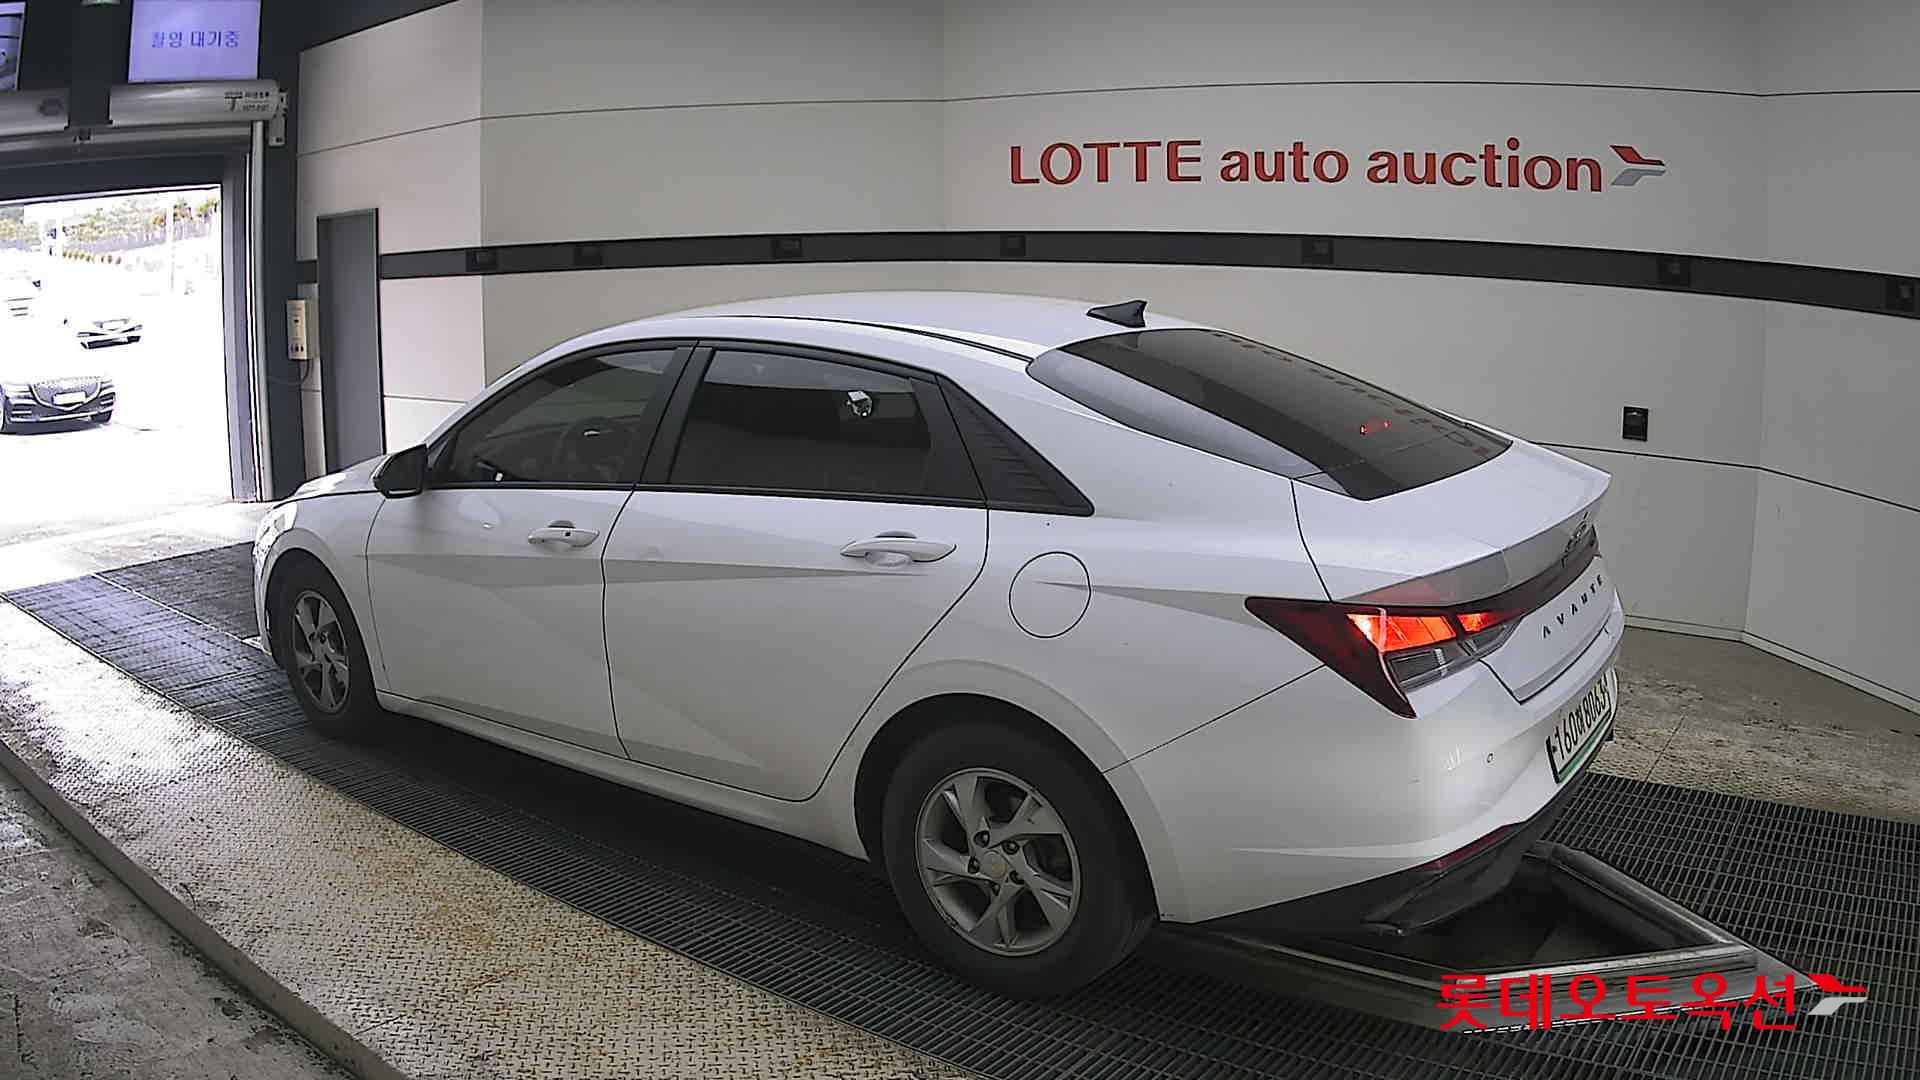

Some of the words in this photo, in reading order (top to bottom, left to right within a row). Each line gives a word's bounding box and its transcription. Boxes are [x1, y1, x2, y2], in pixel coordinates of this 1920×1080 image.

[191, 31, 240, 49] 대기중
[1010, 140, 1201, 185] LOTTE
[1220, 141, 1350, 183] auto
[1366, 137, 1602, 192] auction
[1541, 574, 1603, 639] AVANTE
